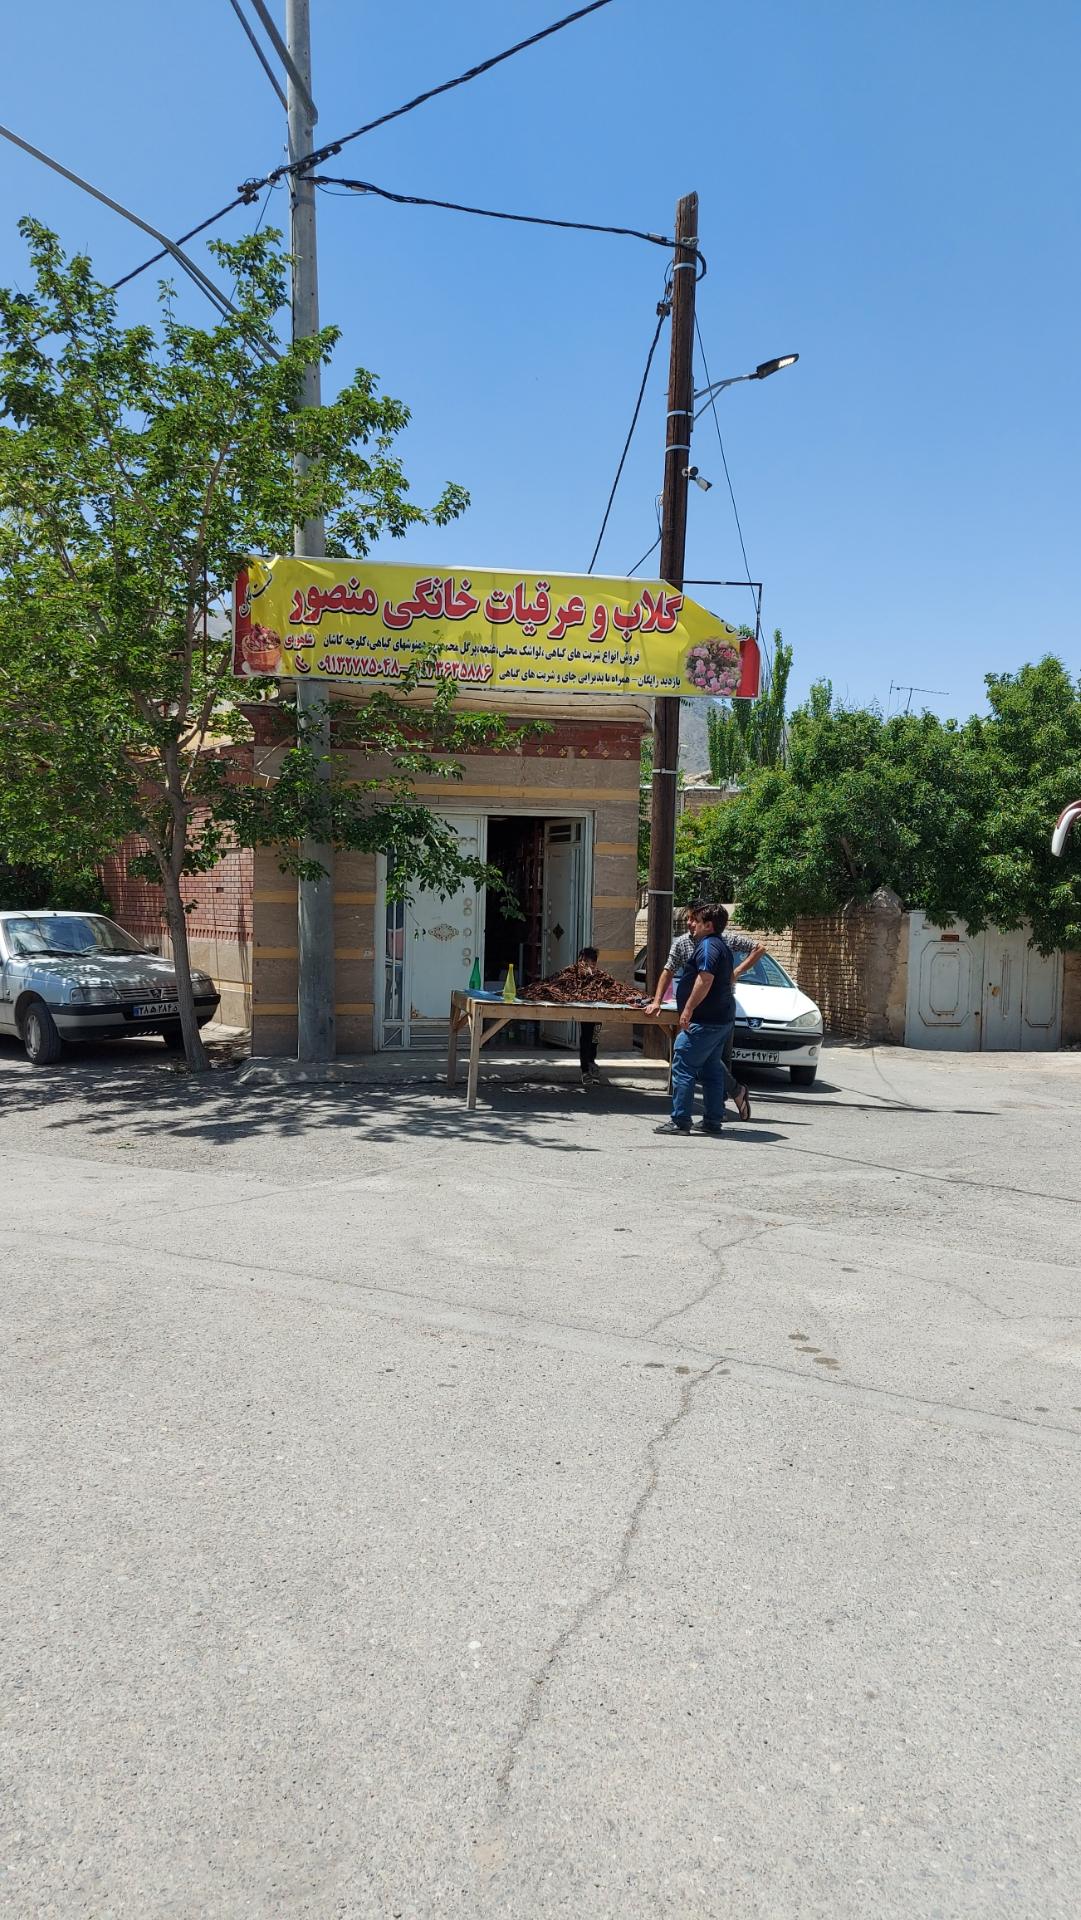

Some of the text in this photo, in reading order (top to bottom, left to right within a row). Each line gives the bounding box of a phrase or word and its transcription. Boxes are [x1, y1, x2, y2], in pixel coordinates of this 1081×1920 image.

[289, 576, 379, 625] منصور
[383, 576, 480, 631] خانگی
[485, 580, 586, 640] عرقیات
[612, 587, 684, 642] گلاب
[588, 603, 609, 641] و
[583, 650, 601, 663] شربت
[602, 650, 619, 664] انواع
[620, 651, 640, 665] فروش
[660, 677, 681, 688] بازدید
